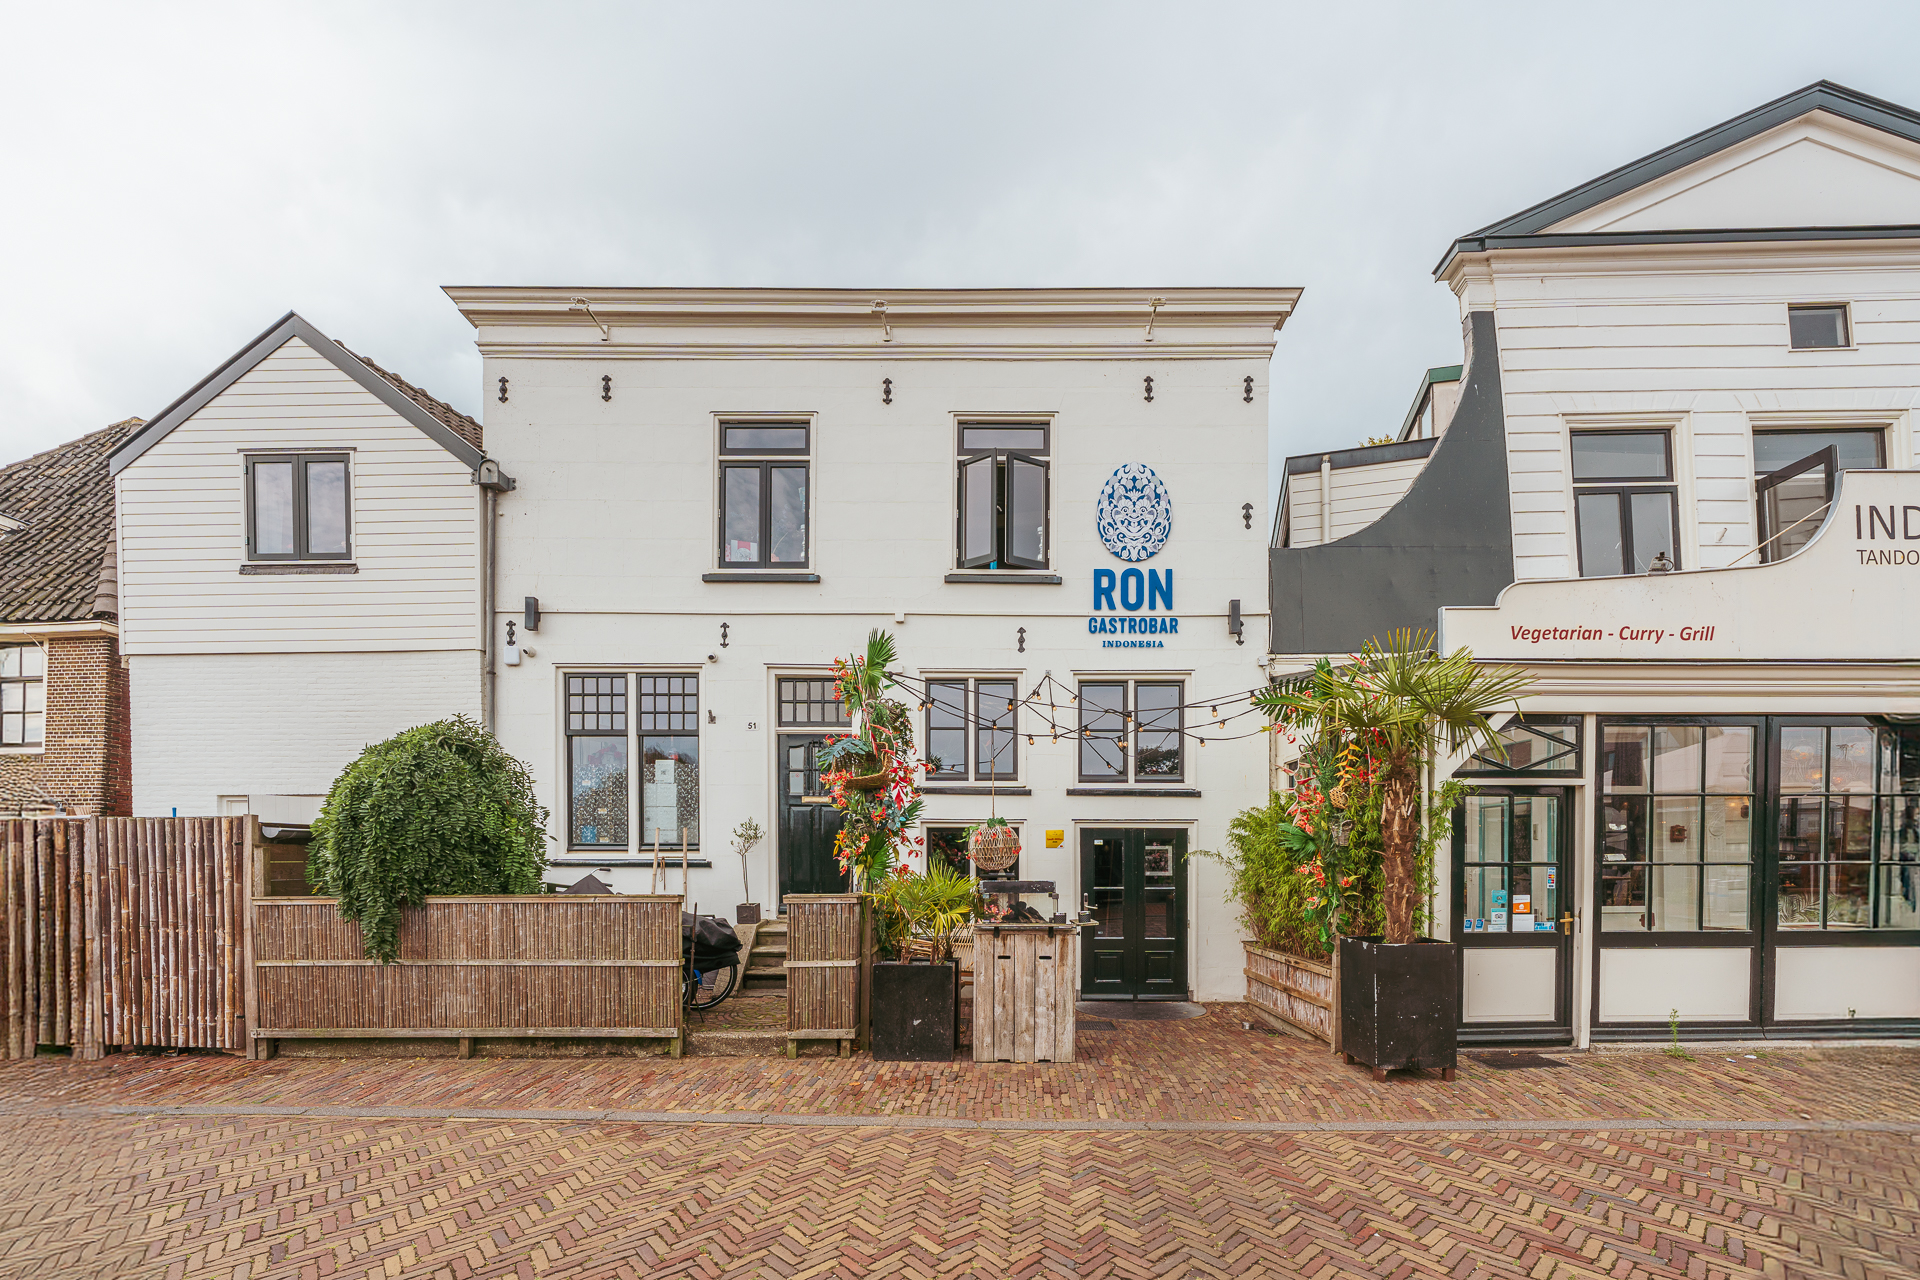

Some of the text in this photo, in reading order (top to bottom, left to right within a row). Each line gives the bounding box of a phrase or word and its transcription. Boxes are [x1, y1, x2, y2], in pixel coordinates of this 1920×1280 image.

[1856, 549, 1920, 566] TANDO
[1093, 567, 1173, 611] RON
[1088, 617, 1179, 634] GASTROBAR
[1511, 625, 1603, 644] Vegetarian
[1619, 626, 1664, 644] Curry
[1679, 626, 1715, 641] Grill
[1102, 640, 1164, 648] INDONESIA
[747, 722, 757, 730] 51
